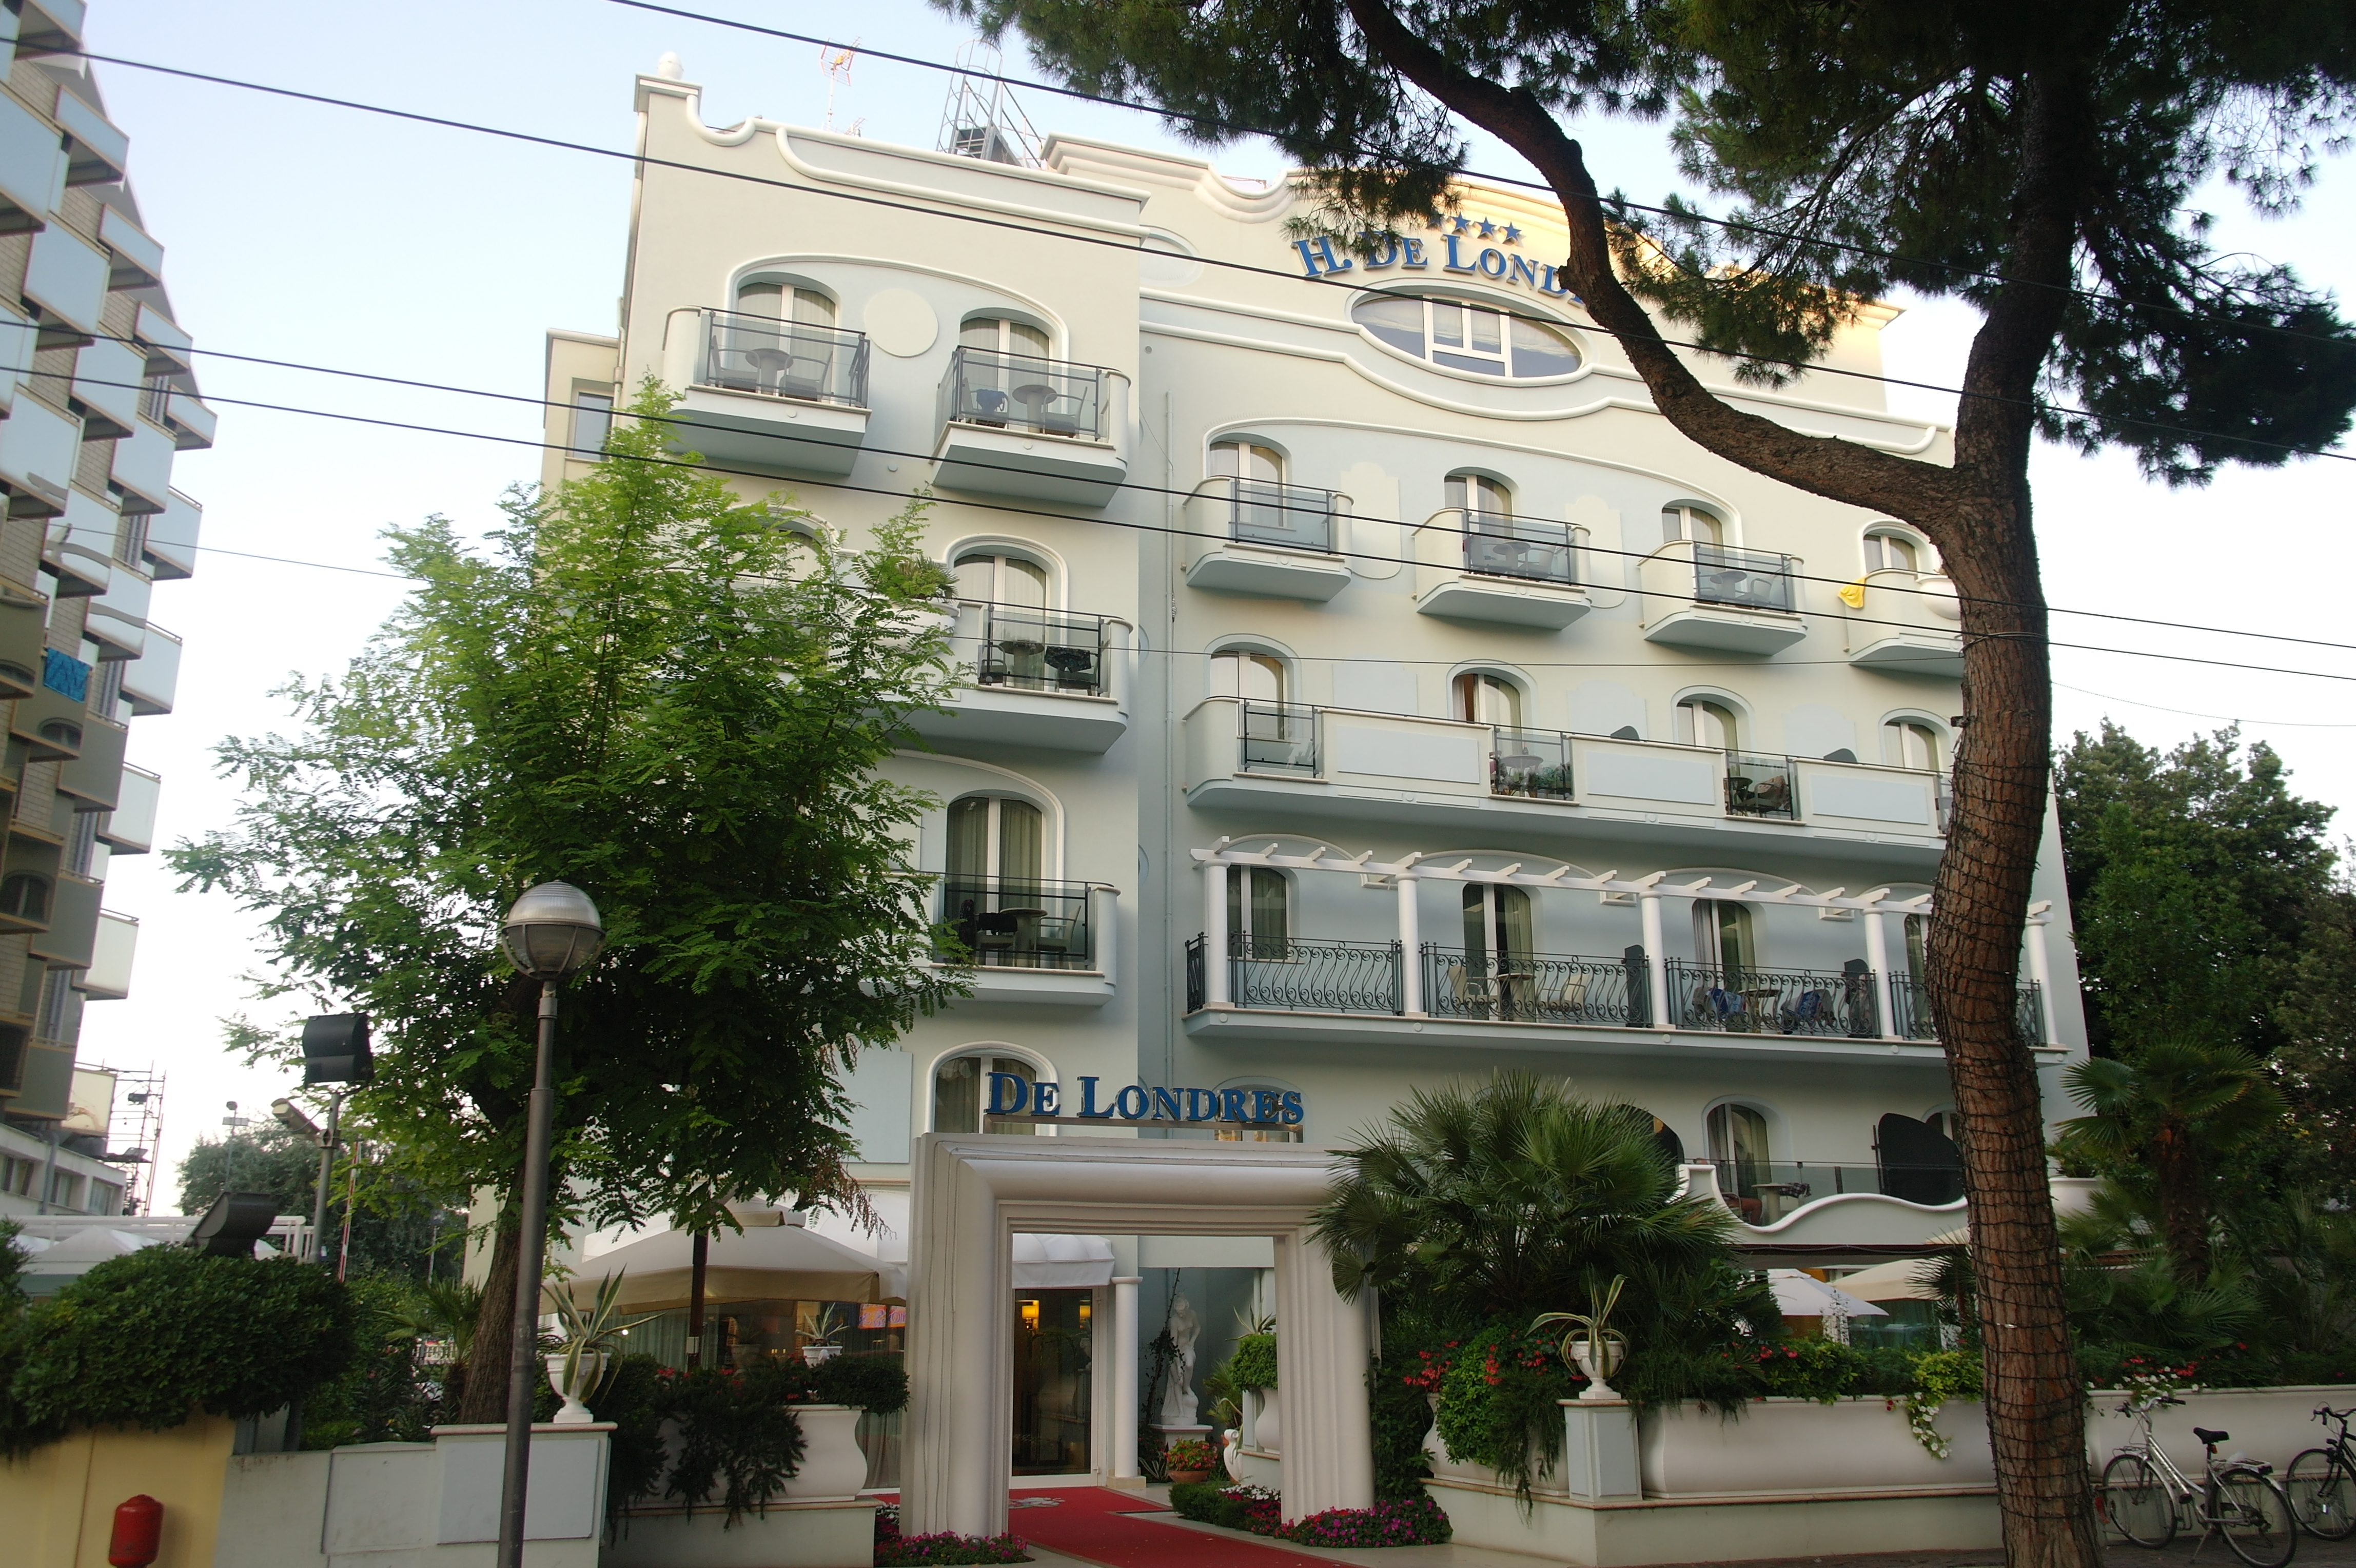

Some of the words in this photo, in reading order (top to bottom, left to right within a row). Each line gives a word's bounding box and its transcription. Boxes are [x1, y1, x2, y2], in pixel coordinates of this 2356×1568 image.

[1441, 233, 1584, 309] LOND
[984, 1072, 1062, 1116] DE
[1077, 1076, 1305, 1124] LONDRES
